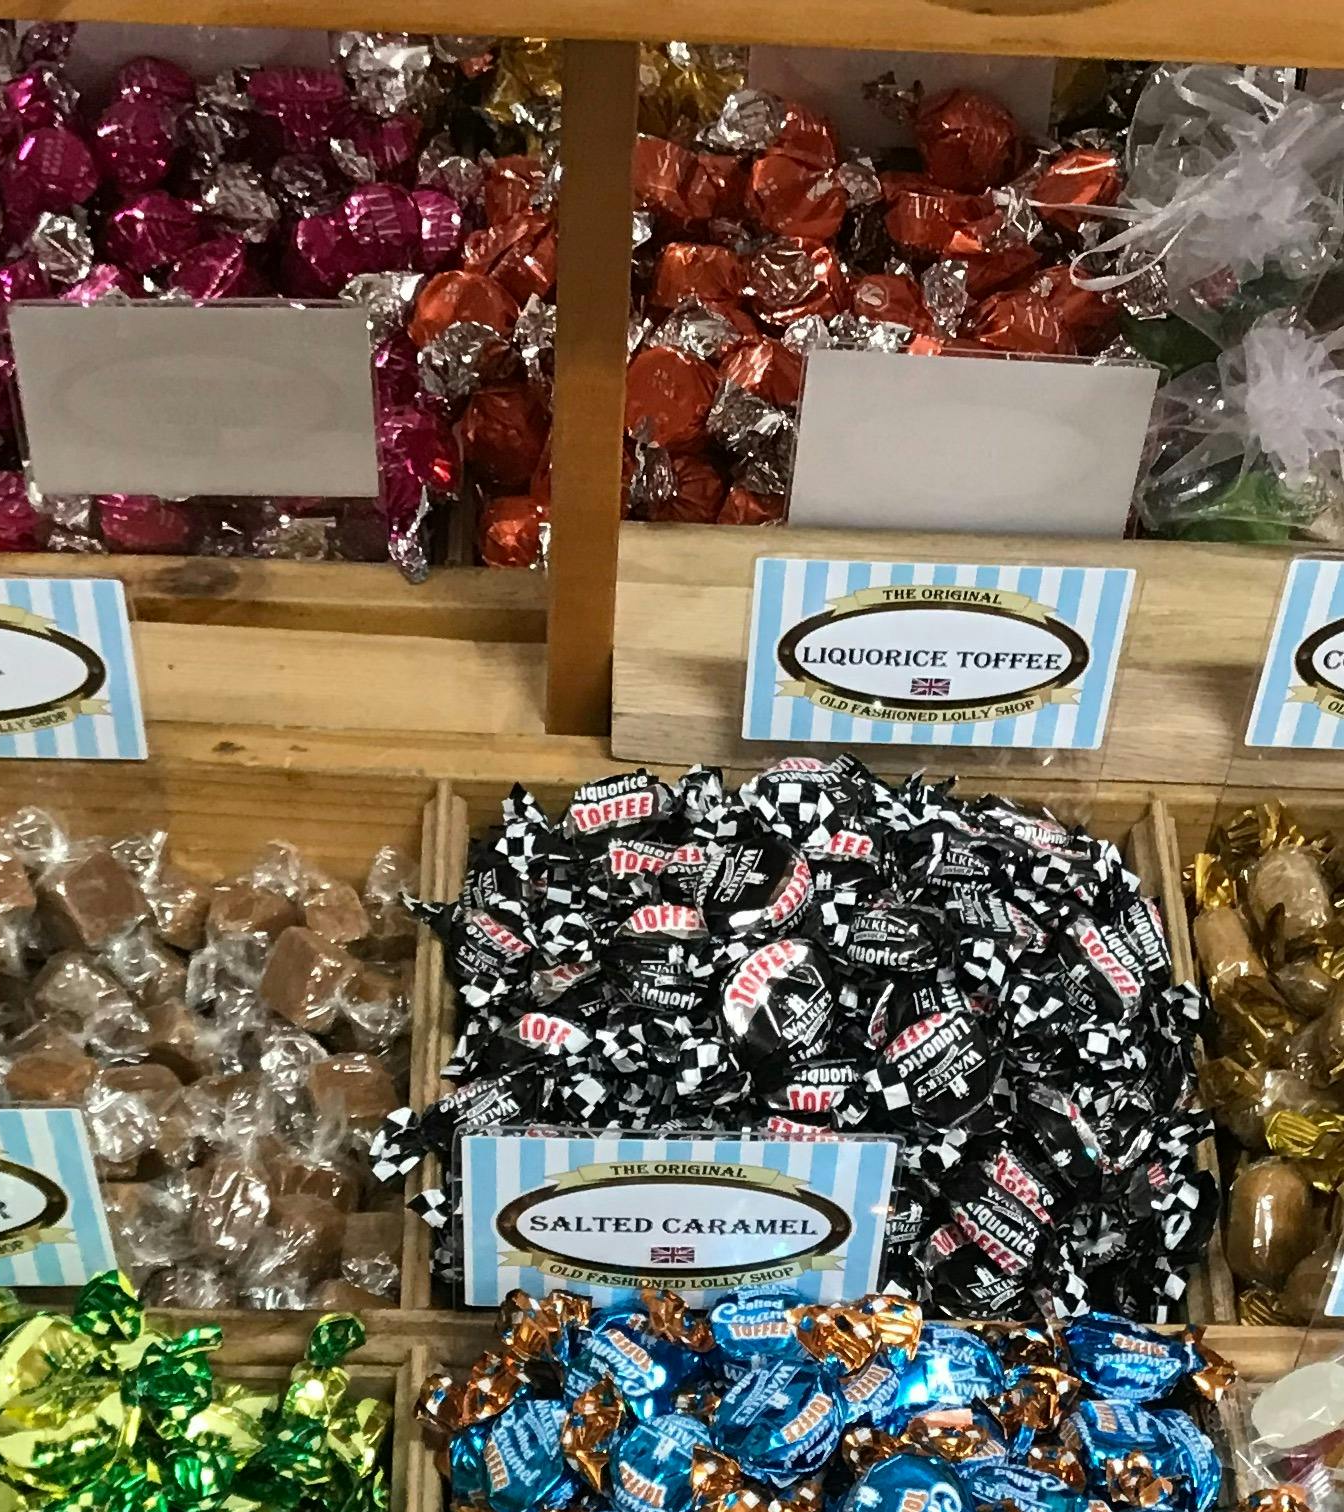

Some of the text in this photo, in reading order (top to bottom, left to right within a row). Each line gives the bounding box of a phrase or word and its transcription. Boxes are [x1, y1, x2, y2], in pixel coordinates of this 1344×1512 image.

[882, 589, 1003, 605] THE ORIGINAL
[801, 646, 1063, 670] LIQUORICE TOFFEE
[819, 695, 1035, 722] OLD FASHIONED LOLLY SHOP
[573, 795, 652, 831] TOFFEE
[729, 939, 797, 1005] TOFFEE
[1081, 929, 1140, 998] TOFFEE
[897, 1017, 972, 1079] Liquorice
[912, 1048, 983, 1101] WALKER'S
[609, 1164, 748, 1178] THE ORIGINAL
[529, 1215, 819, 1236] SALTED CARAMEL
[549, 1264, 794, 1289] OLD FASHIONED LOLLY SHOP
[737, 1300, 783, 1311] Salted
[731, 1322, 792, 1340] TOFFEE
